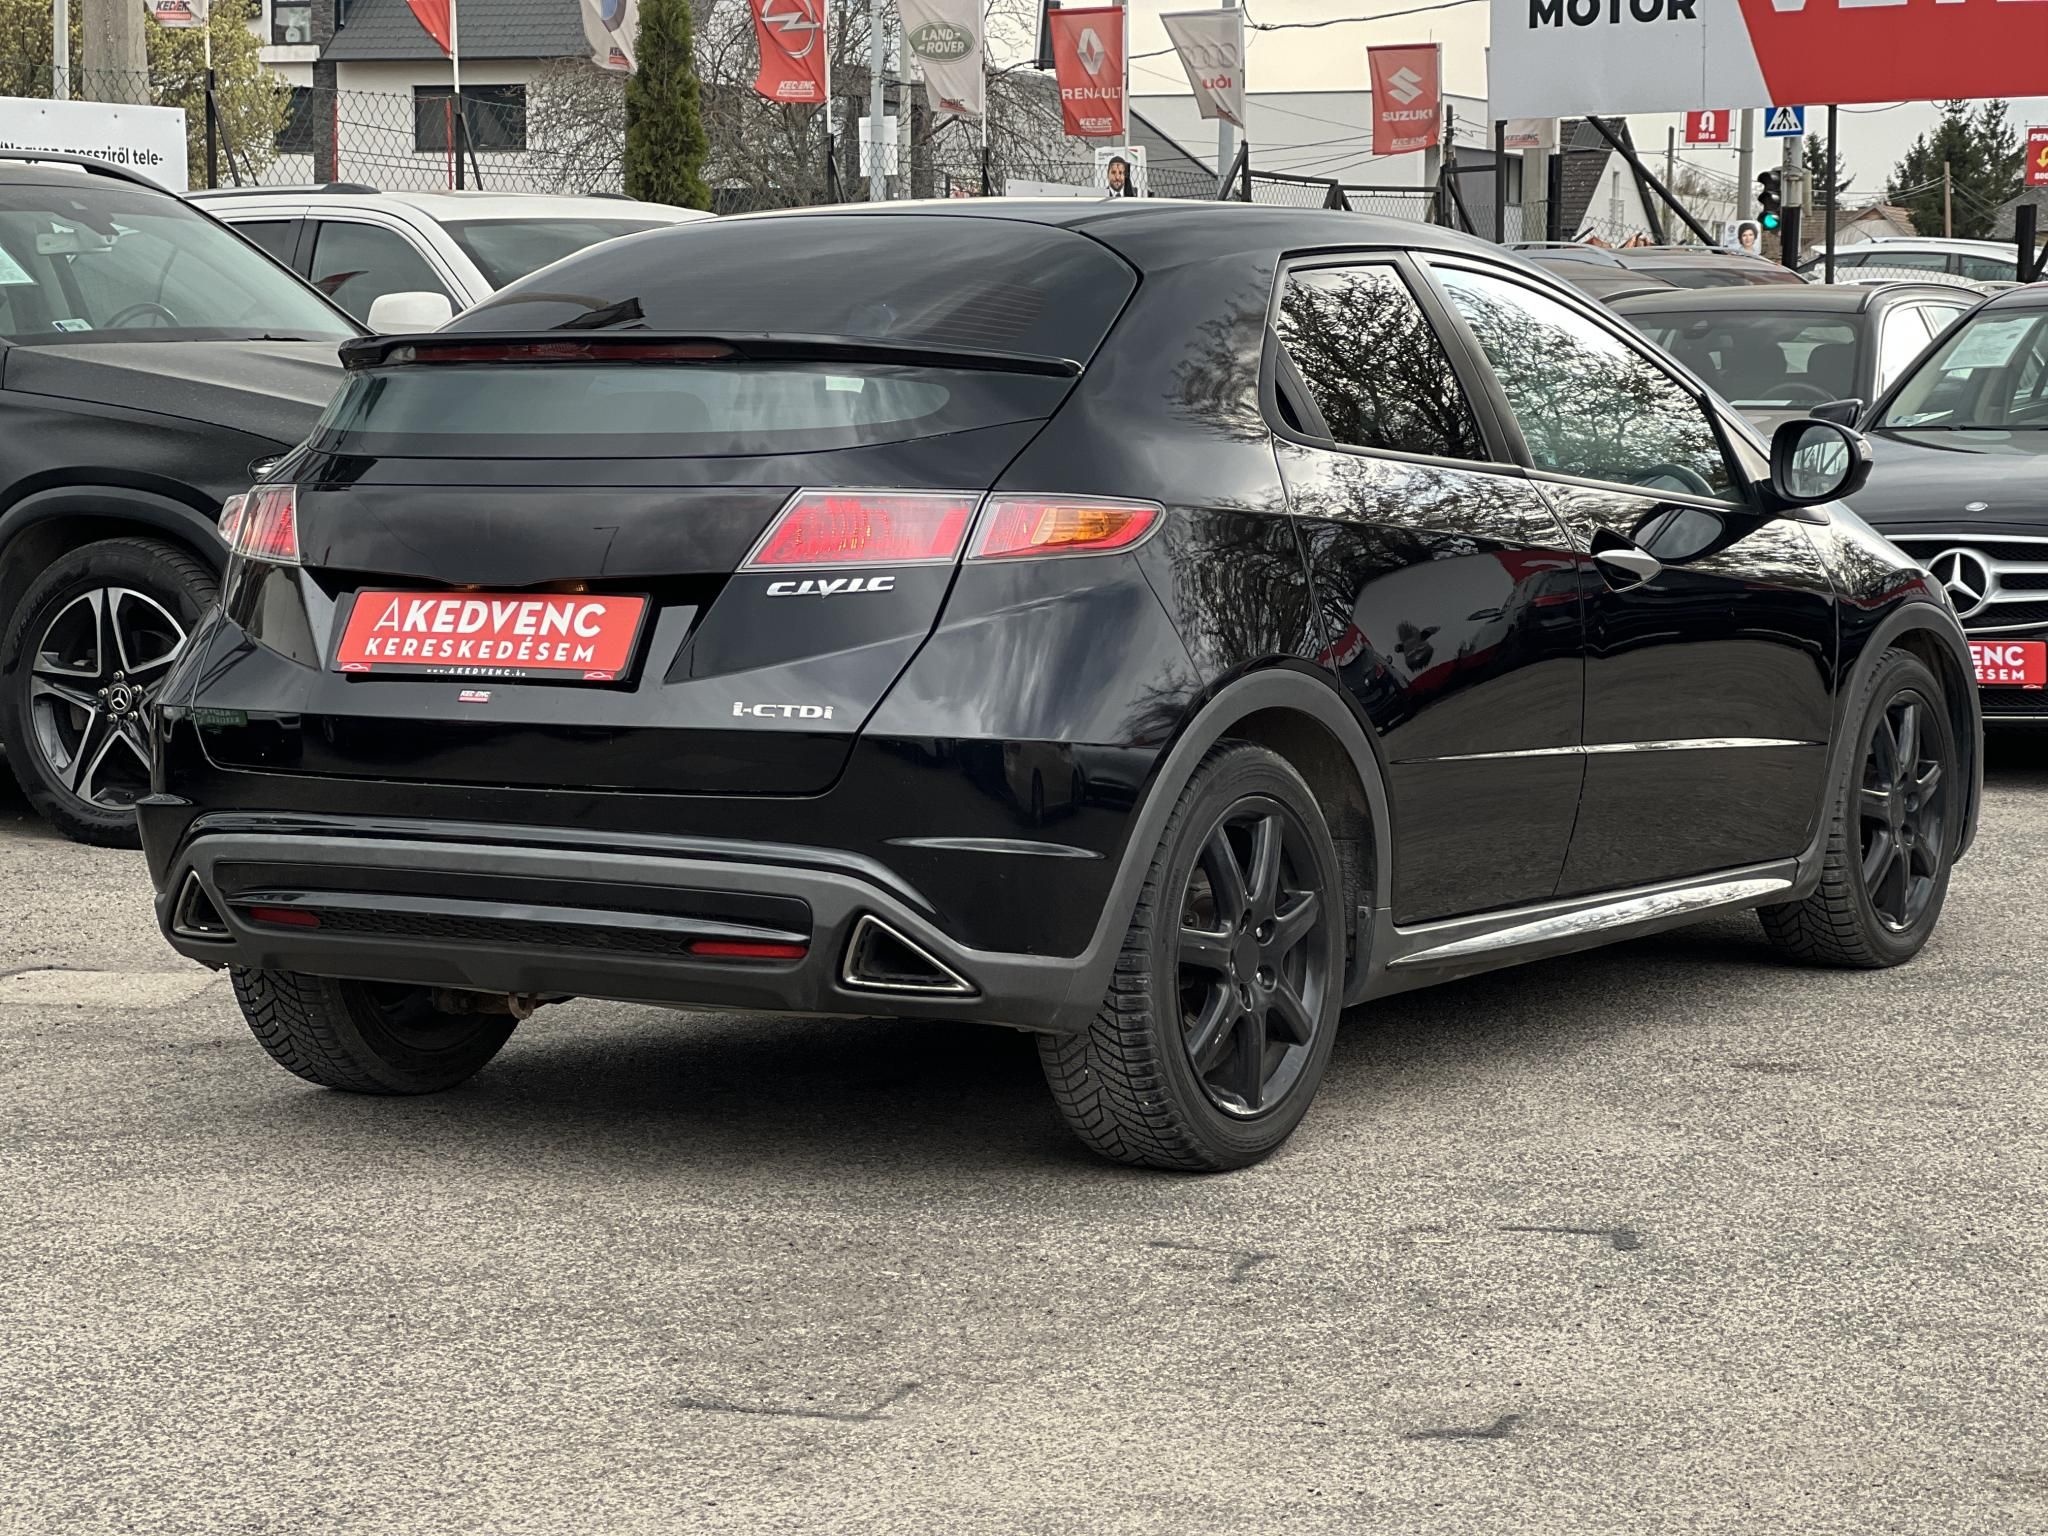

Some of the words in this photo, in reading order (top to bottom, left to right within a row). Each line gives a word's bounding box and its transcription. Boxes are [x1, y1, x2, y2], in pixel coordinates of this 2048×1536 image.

[1202, 74, 1232, 89] udi
[1061, 86, 1122, 100] RENAULT
[1382, 109, 1433, 121] SUZUKI
[133, 148, 163, 166] tele-
[767, 576, 895, 599] CIVIC
[364, 636, 595, 663] KERESKEDÉSEM
